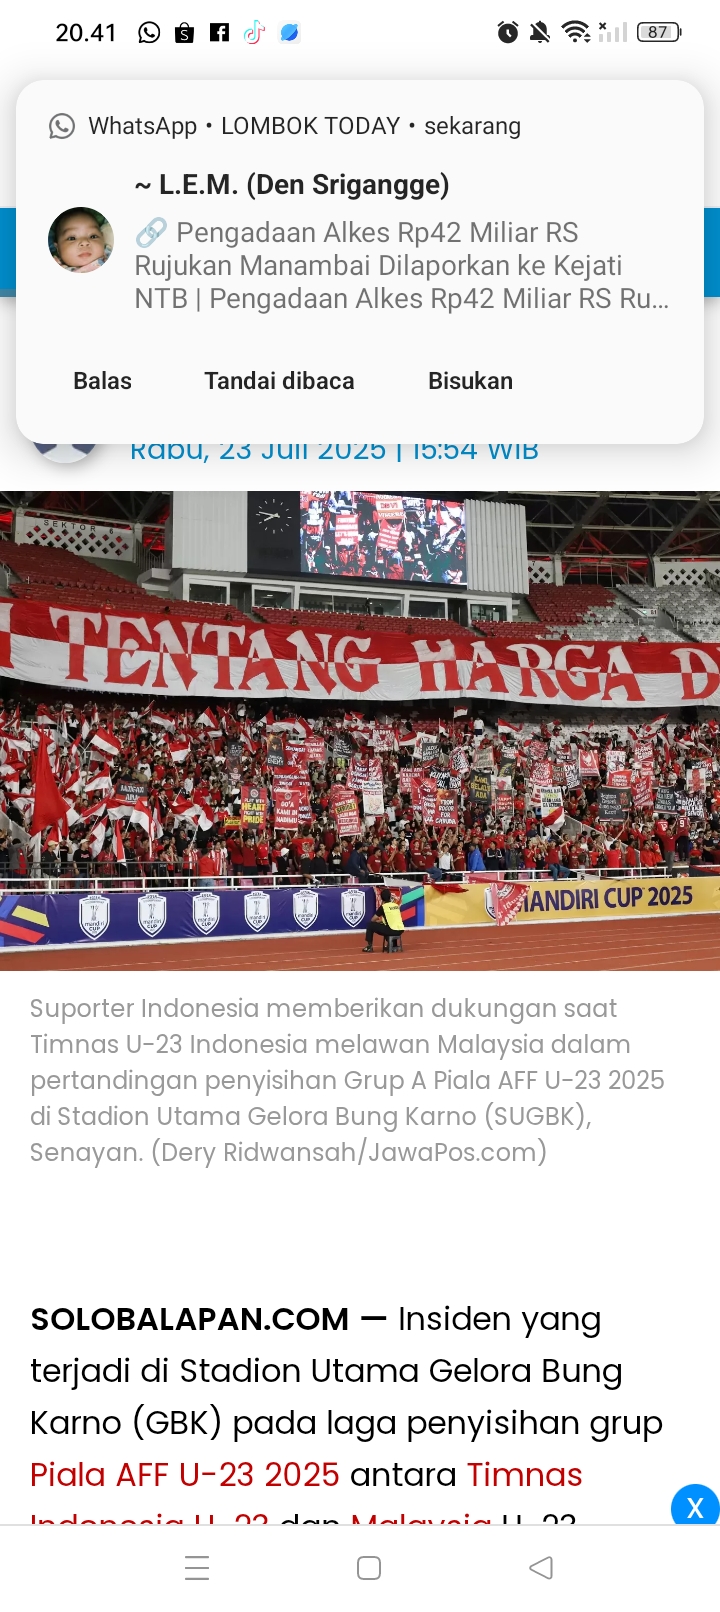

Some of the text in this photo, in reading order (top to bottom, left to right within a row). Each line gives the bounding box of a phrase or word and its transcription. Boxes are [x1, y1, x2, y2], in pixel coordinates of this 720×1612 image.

[55, 22, 115, 43] 20.41
[647, 25, 668, 39] 87
[88, 115, 198, 140] WhatsApp
[222, 115, 319, 135] LOMBOK
[323, 115, 401, 135] TODAY
[424, 115, 521, 140] sekarang
[160, 173, 238, 195] L.E.M.
[246, 171, 304, 201] (Den
[312, 171, 450, 201] Srigangge)
[177, 220, 579, 249] Pengadaan Alkes Rp42 Miliar RS
[135, 253, 622, 282] Rujukan Manambai Dilaporkan ke Kejati
[135, 287, 188, 309] NTB
[210, 286, 348, 315] Pengadaan
[354, 286, 423, 309] Alkes
[431, 287, 495, 315] Rp42
[503, 286, 572, 309] Miliar
[579, 287, 612, 309] RS
[73, 370, 132, 390] Balas
[203, 370, 355, 390] Tandai dibaca
[428, 370, 513, 390] Bisukan
[43, 519, 114, 535] SEKTOR 6
[48, 606, 382, 695] TENTANG
[410, 638, 646, 702] HARGA
[242, 802, 267, 812] HEART
[475, 791, 488, 799] ADA
[243, 814, 264, 824] PRIDE
[276, 807, 291, 815] KAMI
[679, 819, 685, 828] 9
[604, 886, 643, 909] CUP
[647, 885, 693, 907] 2025
[30, 996, 618, 1025] Suporter Indonesia memberikan dukungan saat
[30, 1033, 630, 1061] Timnas U-23 Indonesia melawan Malaysia dalam
[31, 1069, 665, 1097] pertandingan penyisihan Grup A Piala AFF U-23 2025
[30, 1102, 592, 1133] di Stadion Utama Gelora Bung Karno (SUGBK),
[30, 1138, 547, 1169] Senayan. (Dery Ridwansah/JawaPos.com)
[31, 1307, 349, 1331] SOLOBALAPAN.COM
[399, 1304, 511, 1331] Insiden
[521, 1311, 601, 1339] yang
[30, 1356, 622, 1391] terjadi di Stadion Utama Gelora Bung
[31, 1403, 663, 1443] Karno (GBK) pada laga penyisihan grup
[31, 1460, 583, 1487] Piala AFF U-23 2025 antara Timnas
